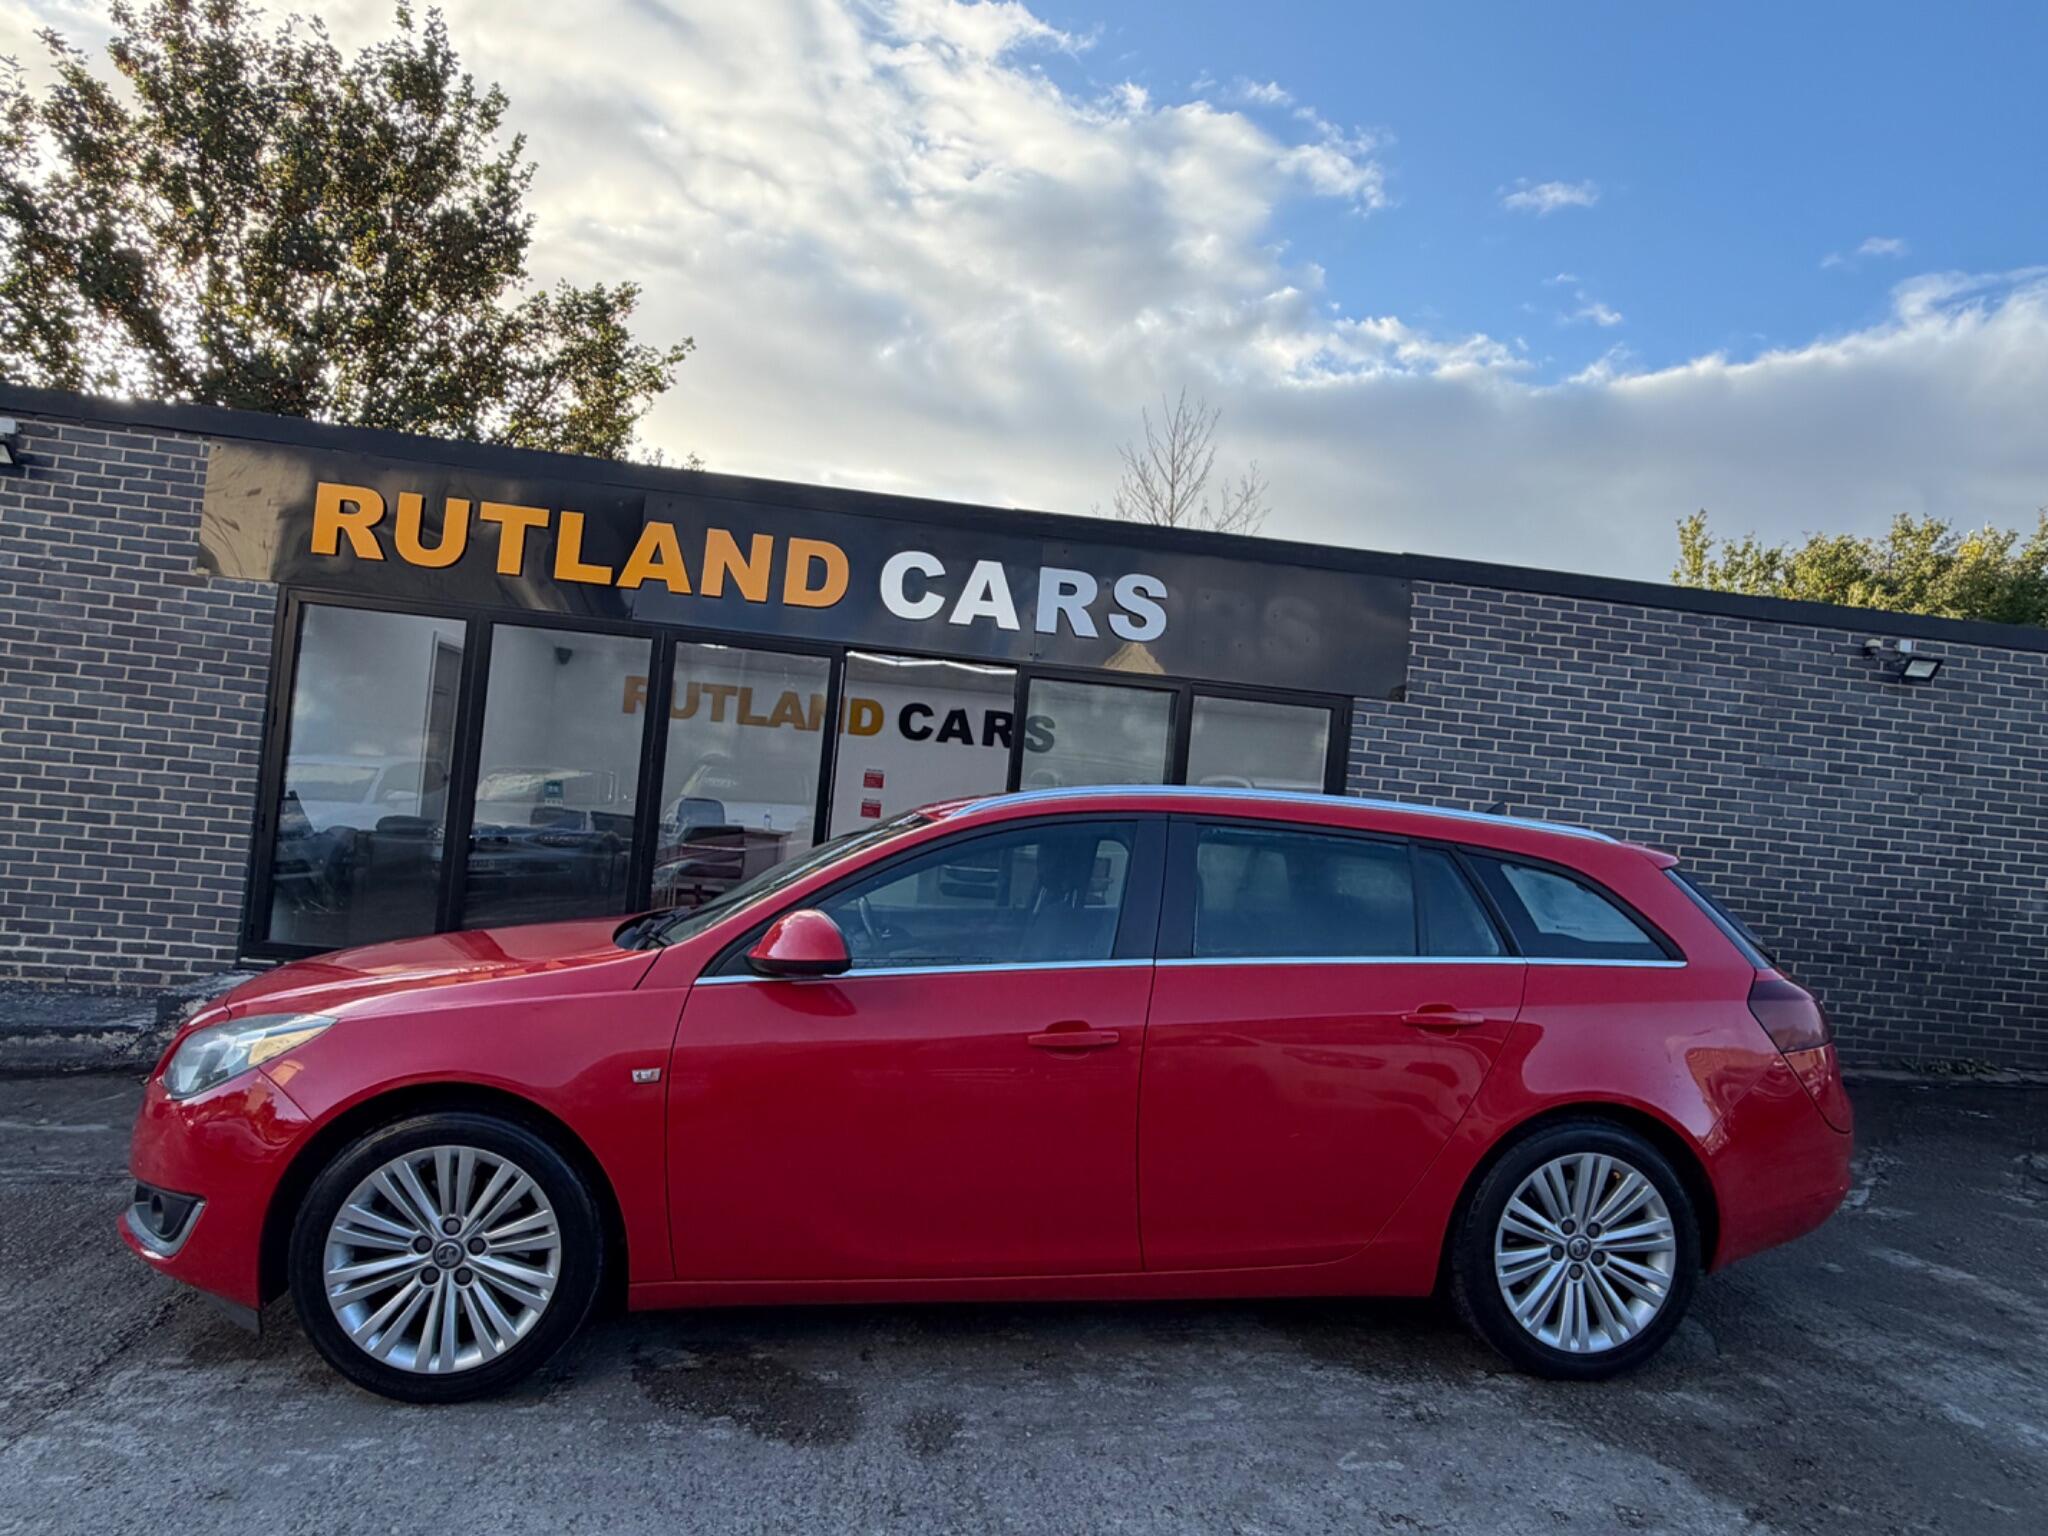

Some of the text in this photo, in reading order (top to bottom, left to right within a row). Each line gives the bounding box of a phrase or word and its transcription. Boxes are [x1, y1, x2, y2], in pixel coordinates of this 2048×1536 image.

[310, 482, 850, 608] RUTLAND
[880, 550, 1168, 642] CARS
[898, 702, 1056, 753] CARS
